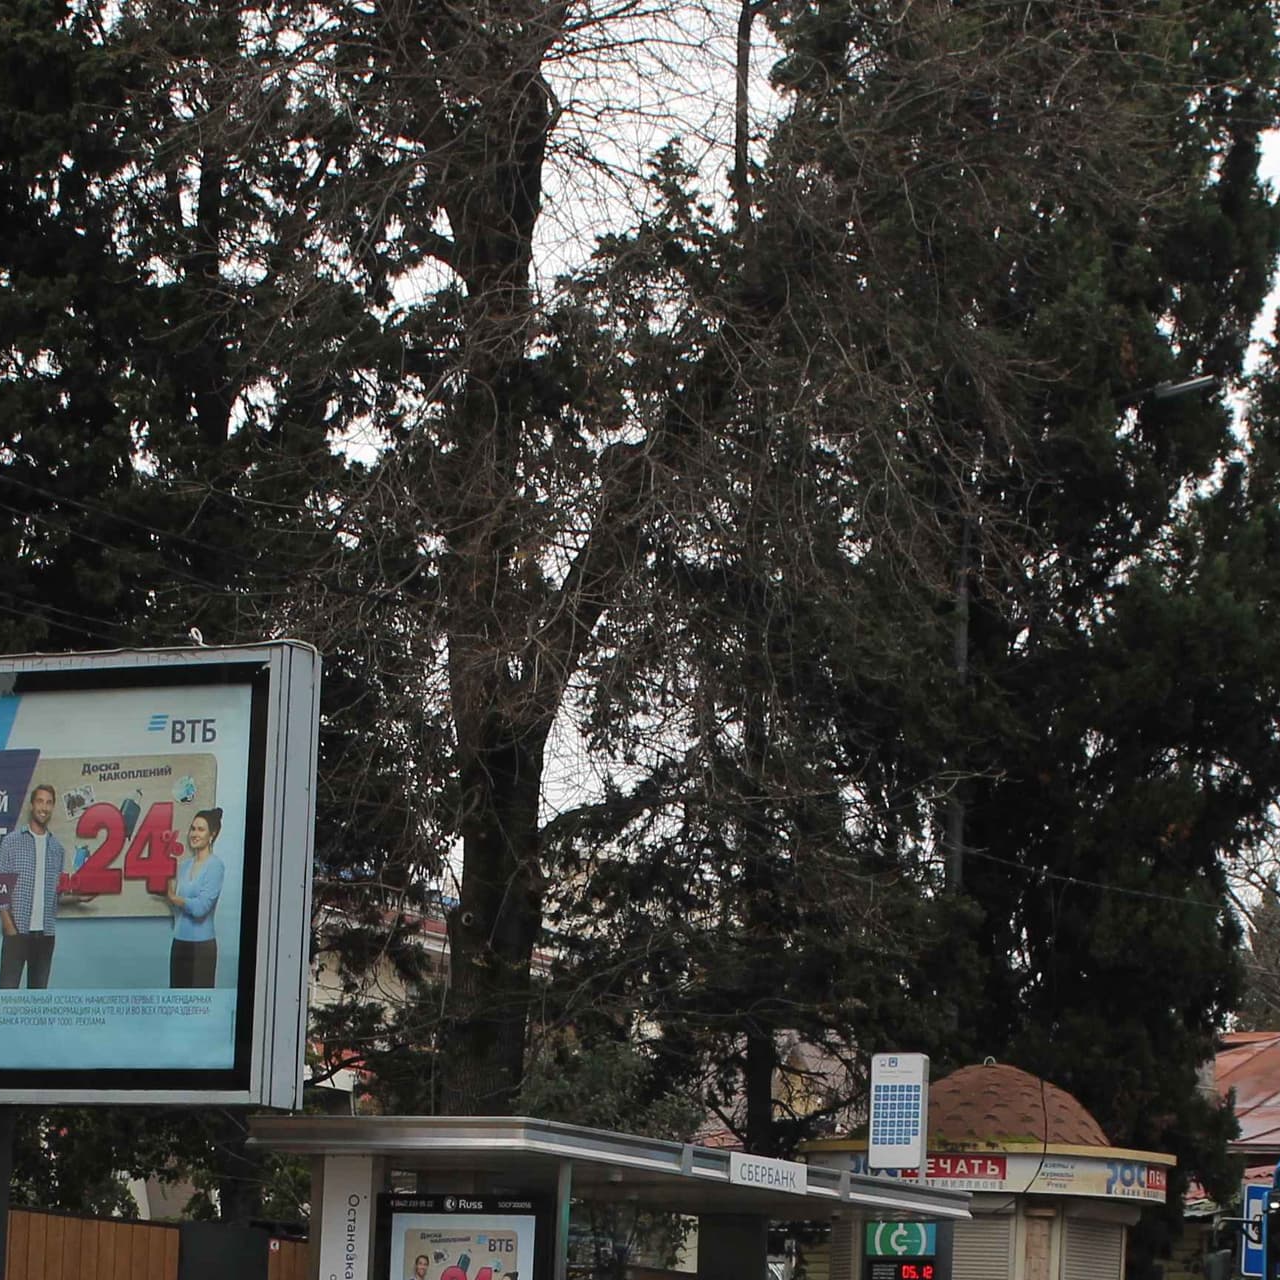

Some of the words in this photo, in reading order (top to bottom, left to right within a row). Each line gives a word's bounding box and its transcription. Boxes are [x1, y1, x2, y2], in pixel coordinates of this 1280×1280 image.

[170, 718, 217, 744] ВТБ
[81, 762, 120, 776] Доска
[740, 1163, 796, 1189] СБЕРБАНК
[906, 1157, 1000, 1176] ЕЧАТЬ
[458, 1200, 483, 1209] Russ
[344, 1194, 361, 1280] Остановка
[488, 1238, 514, 1253] ВТБ
